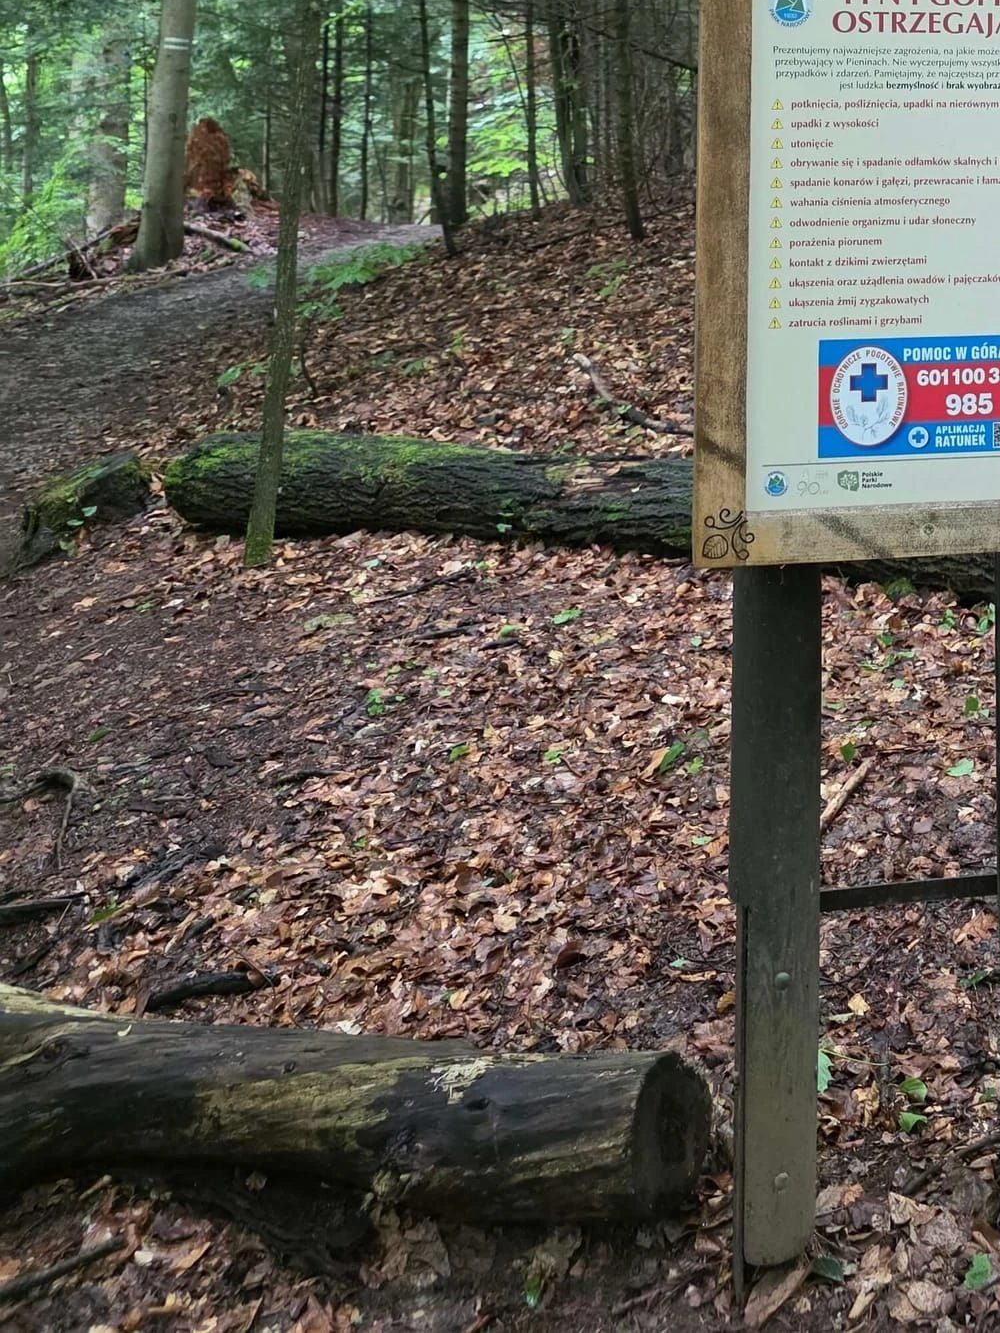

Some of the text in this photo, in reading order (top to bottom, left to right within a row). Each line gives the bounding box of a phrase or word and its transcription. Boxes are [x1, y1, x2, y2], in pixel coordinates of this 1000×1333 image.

[773, 46, 830, 56] Prezentujemy
[833, 46, 891, 56] najważniejsze
[894, 47, 940, 56] zagrożenia,
[956, 47, 975, 56] jakie
[775, 57, 833, 67] przebywający
[846, 57, 889, 66] Pieninach.
[893, 58, 907, 66] Nie
[909, 58, 969, 68] wyczerpujemy
[776, 68, 827, 79] przypadków
[836, 68, 871, 77] zdarzeń.
[874, 69, 924, 79] Pamiętajmy,
[927, 69, 936, 77] że
[939, 70, 984, 79] najczęstszą
[840, 81, 853, 92] jest
[856, 80, 883, 89] ludzka
[886, 80, 939, 91] bezmyślność
[946, 80, 965, 89] brak
[791, 99, 841, 110] potknięcia,
[844, 98, 900, 110] pośliźnięcia,
[903, 99, 933, 110] upadki
[936, 100, 946, 108] na
[950, 99, 999, 110] nierównym
[791, 118, 822, 130] upadki
[833, 118, 879, 130] wysokości
[791, 139, 833, 150] utonięcie
[790, 157, 838, 168] obrywanie
[842, 157, 854, 168] się
[857, 157, 860, 166] i
[862, 157, 902, 168] spadanie
[905, 156, 951, 166] odłamków
[954, 156, 992, 167] skalnych
[994, 156, 997, 165] i
[790, 177, 830, 189] spadanie
[834, 177, 873, 186] konarów
[876, 177, 879, 185] i
[882, 176, 910, 188] gałęzi,
[914, 175, 974, 188] przewracanie
[977, 176, 979, 184] i
[790, 195, 950, 207] wahania ciśnienia atmosferycznego
[790, 215, 976, 228] odwodnienie organizmu i udar słoneczny
[790, 237, 882, 249] porażenia piorunem
[790, 258, 824, 267] kontakt
[835, 257, 868, 266] dzikimi
[872, 255, 927, 266] zwierzętami
[789, 277, 834, 289] ukąszenia
[860, 276, 904, 287] użądlenia
[907, 275, 945, 284] owadów
[948, 274, 951, 283] i
[789, 295, 929, 309] ukąszenia żmij zygzakowatych
[789, 315, 922, 328] zatrucia roślinami i grzybami
[904, 347, 951, 361] POMOC
[956, 346, 967, 360] W
[917, 368, 949, 386] 601
[952, 368, 985, 385] 100
[833, 352, 861, 394] OCHOTNICZE
[866, 349, 902, 378] POGOTOWIE
[889, 381, 904, 427] RATUNKOWE
[946, 392, 993, 416] 985
[936, 424, 986, 434] APLIKACJA
[935, 434, 986, 448] RATUNEK
